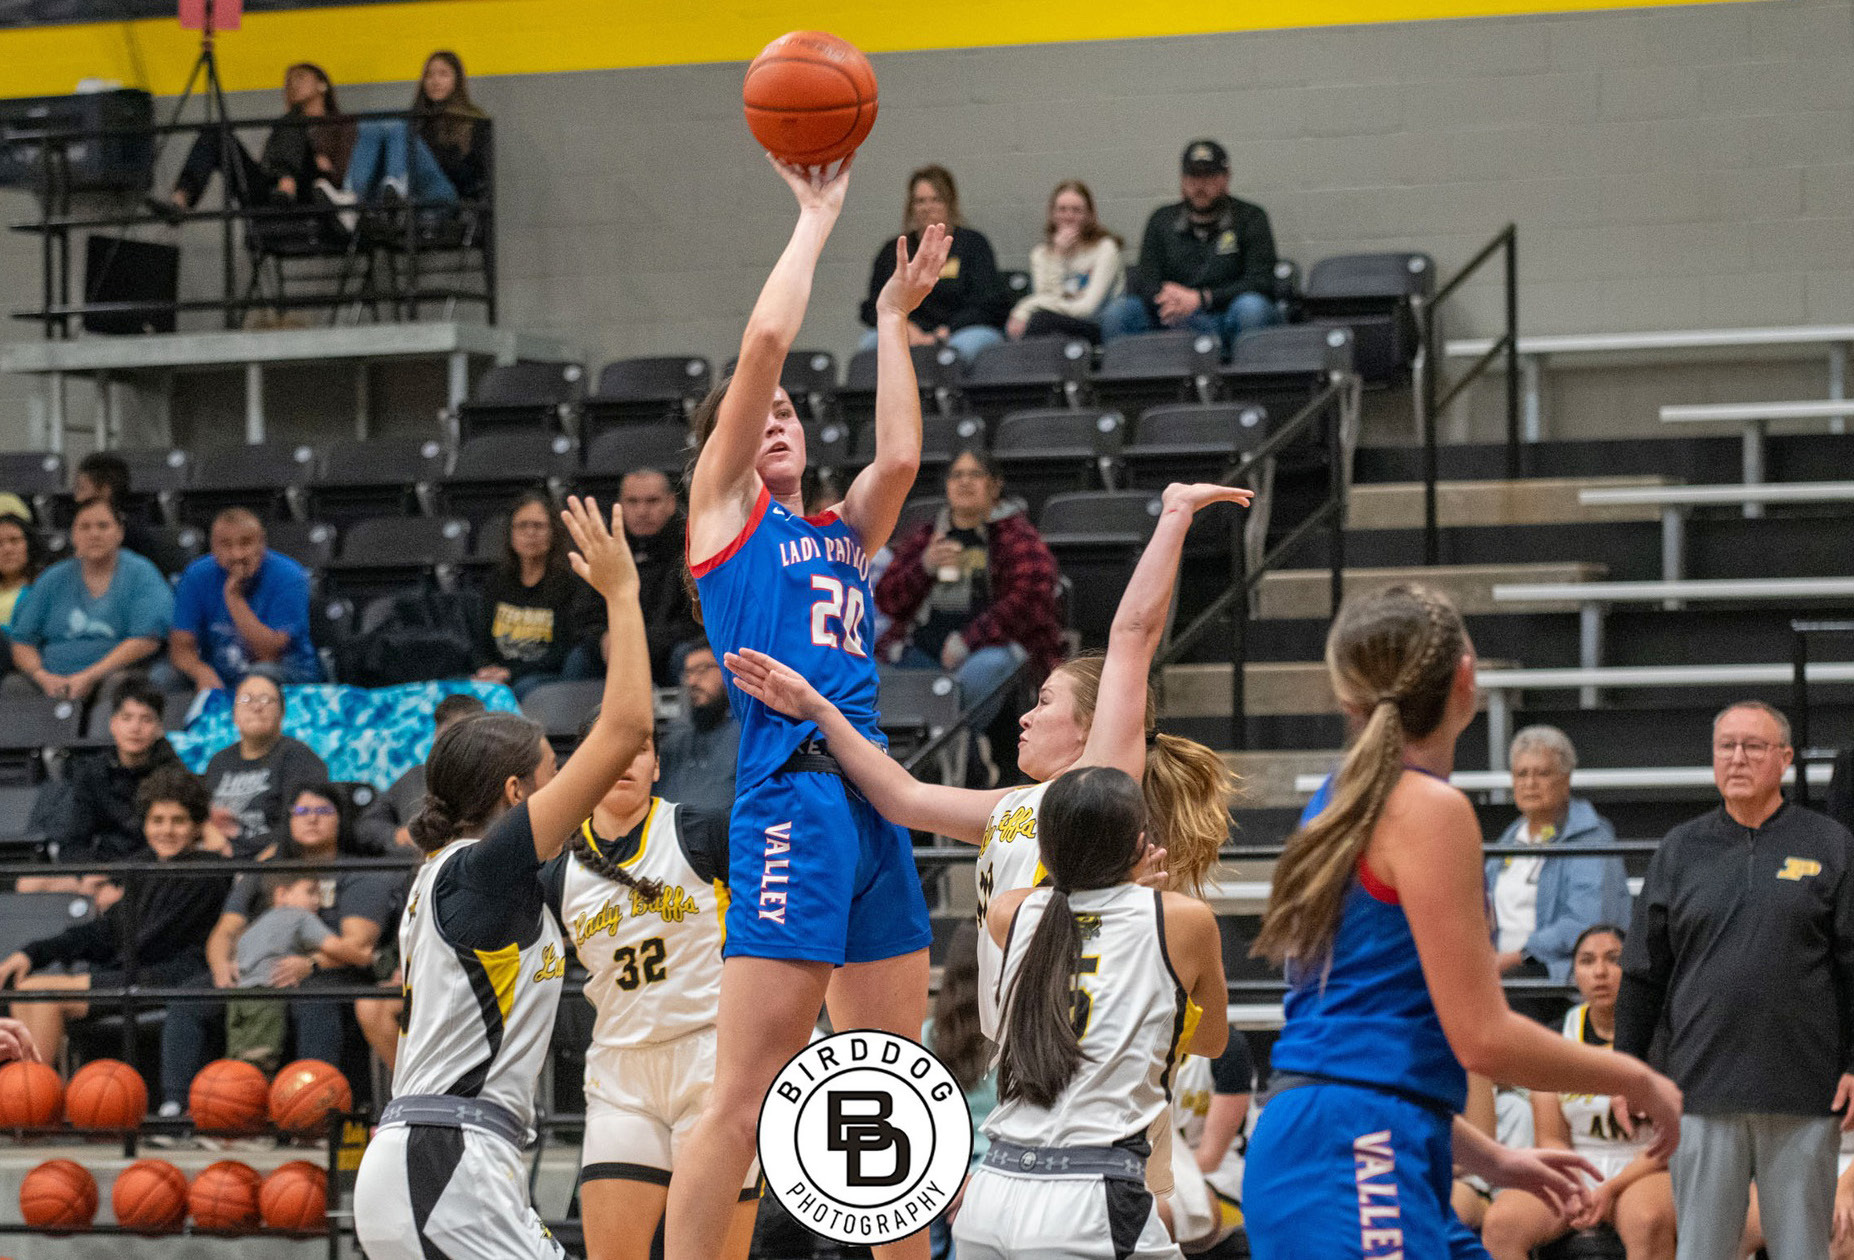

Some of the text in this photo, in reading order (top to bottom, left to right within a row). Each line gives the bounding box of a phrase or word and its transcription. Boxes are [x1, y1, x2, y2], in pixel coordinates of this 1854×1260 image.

[810, 573, 868, 658] 20
[758, 820, 793, 925] VALLEY
[574, 899, 623, 946] Lady
[613, 936, 667, 991] 32
